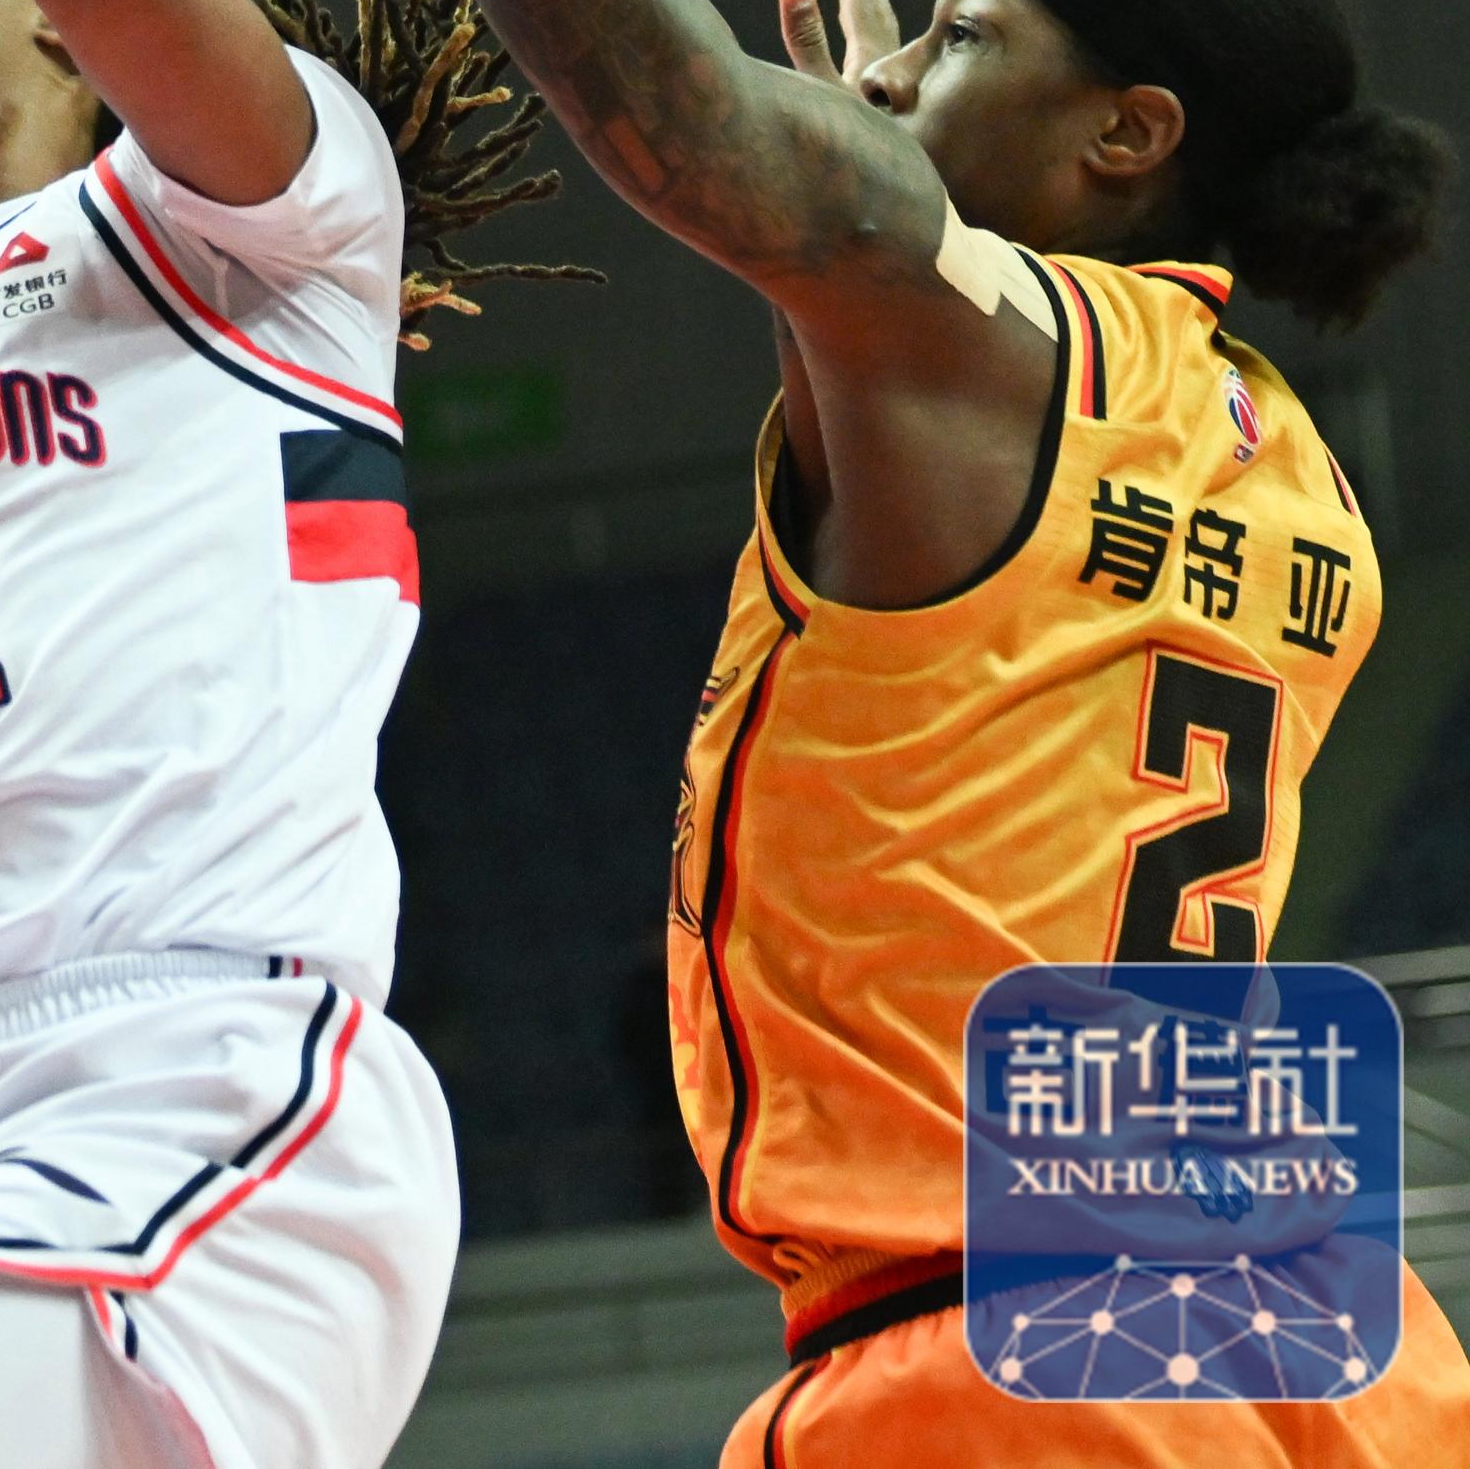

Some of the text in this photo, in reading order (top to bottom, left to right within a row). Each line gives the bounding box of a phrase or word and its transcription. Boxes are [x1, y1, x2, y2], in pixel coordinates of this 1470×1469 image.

[3, 293, 55, 318] CGB
[1077, 477, 1352, 659] 肯帝亚
[1103, 638, 1283, 1018] 2
